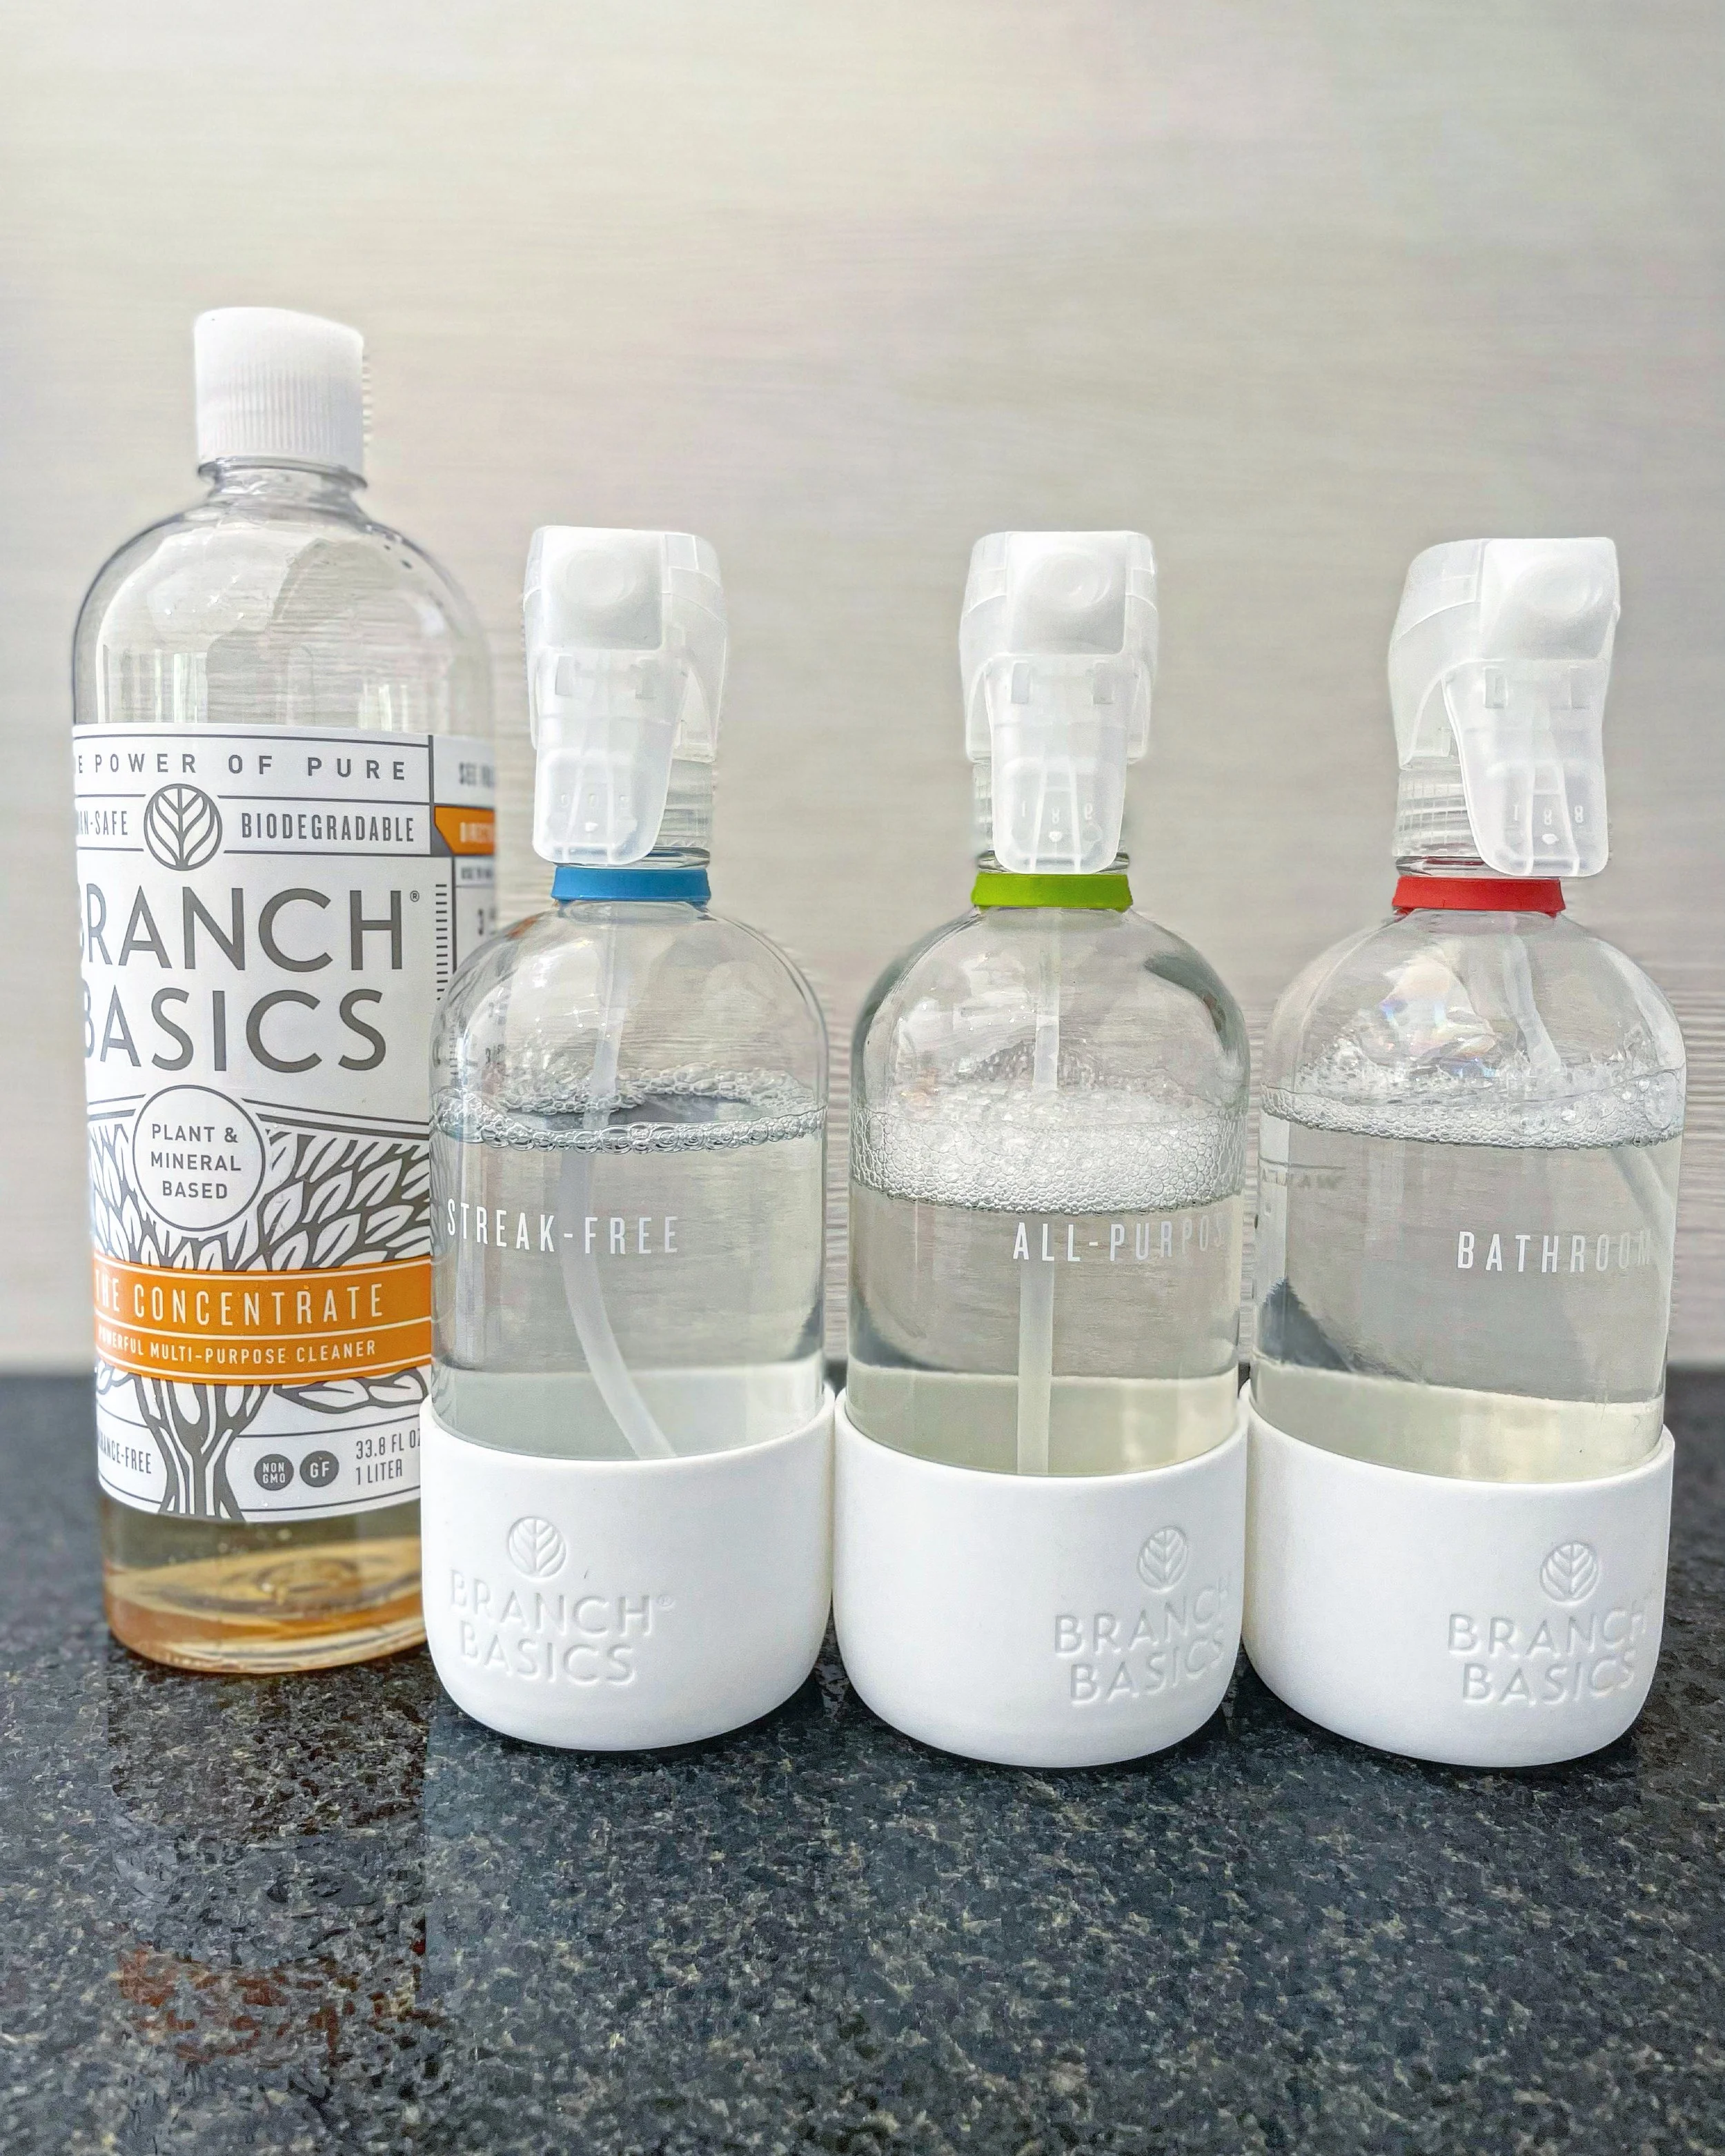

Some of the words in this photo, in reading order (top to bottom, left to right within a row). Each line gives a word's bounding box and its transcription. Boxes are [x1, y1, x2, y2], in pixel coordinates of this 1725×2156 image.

[95, 753, 197, 773] POWER
[228, 754, 273, 775] OF
[307, 757, 406, 780] PURE
[241, 812, 415, 843] BIODEGRADABLE
[151, 1123, 215, 1143] PLANT
[224, 1127, 239, 1143] &
[150, 1151, 241, 1172] MINERAL
[162, 1180, 228, 1199] BASED
[446, 1198, 679, 1255] STREAK-FREE
[95, 1269, 120, 1312] THE
[134, 1283, 384, 1327] CONCENTRATE
[98, 1324, 144, 1356] POWERFUL
[150, 1342, 286, 1365] MULTI-PURPOSE
[296, 1339, 376, 1363] CLEANER
[355, 1436, 386, 1460] 33.8
[391, 1432, 404, 1453] FL
[262, 1462, 285, 1473] NON
[262, 1472, 286, 1484] GMO
[309, 1461, 330, 1478] GF
[355, 1466, 361, 1485] 1
[367, 1458, 403, 1484] LITER
[460, 1621, 637, 1686] BASICS
